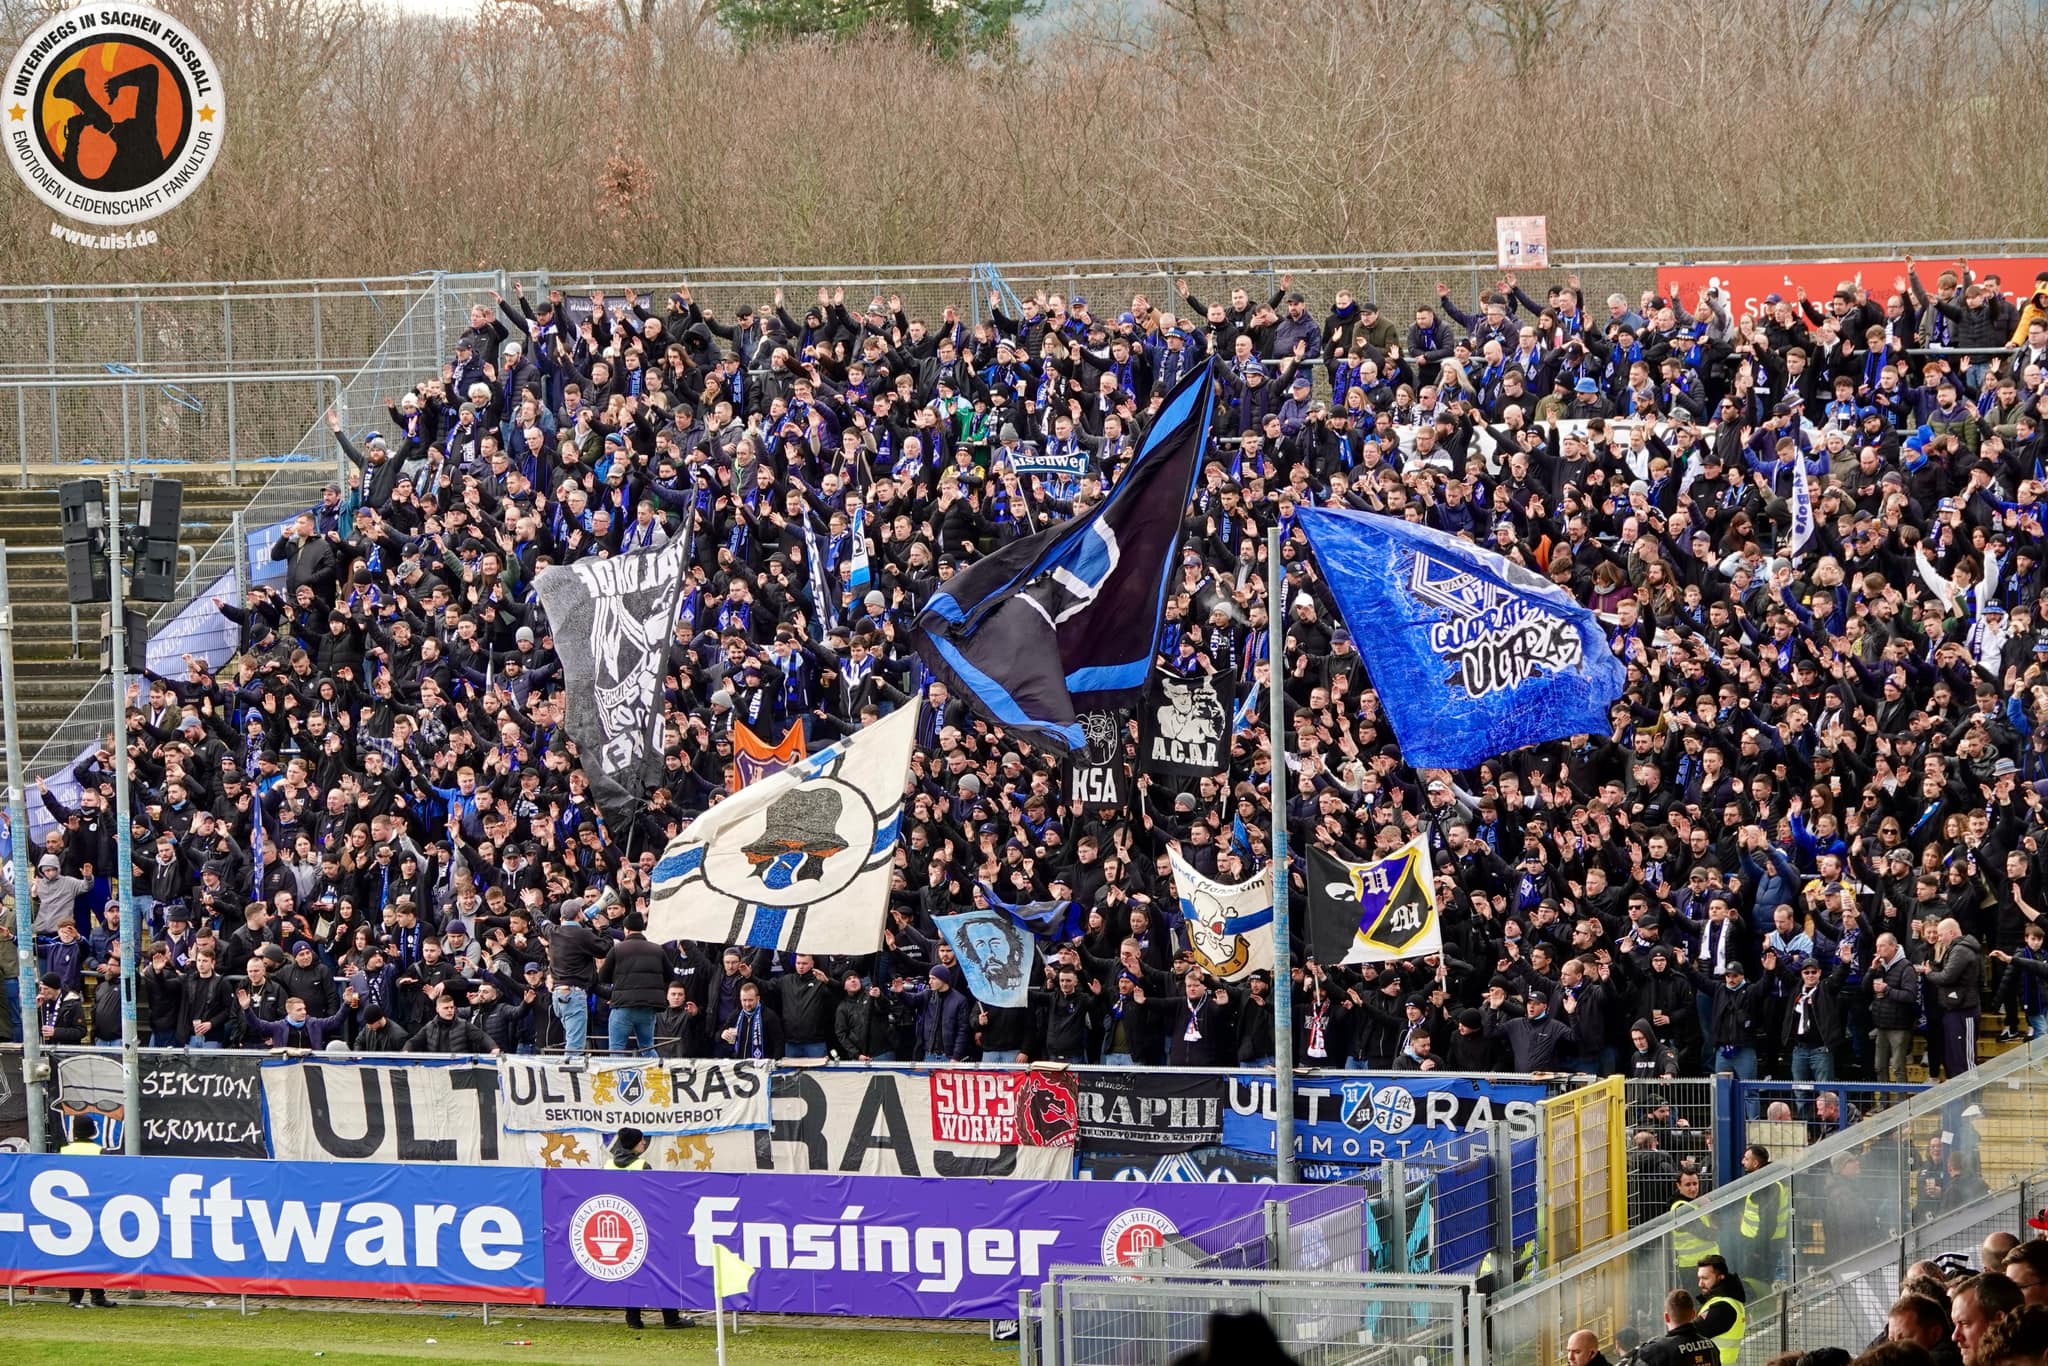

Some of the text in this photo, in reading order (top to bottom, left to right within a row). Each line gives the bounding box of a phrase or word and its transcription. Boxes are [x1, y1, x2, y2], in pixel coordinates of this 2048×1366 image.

[1072, 766, 1118, 802] KSA
[142, 1071, 256, 1100] SEKTION
[509, 1060, 762, 1106] ULT RAS
[936, 1073, 1015, 1116] SUPS
[303, 1065, 499, 1161] ULT
[545, 1107, 723, 1124] SEKTION STADIONVERBOT
[1077, 1092, 1220, 1127] RAPHI
[144, 1119, 262, 1145] KROMILA
[938, 1114, 1014, 1142] WORMS
[687, 1196, 1061, 1293] Ensinger
[583, 1257, 635, 1277] ENSINGEN
